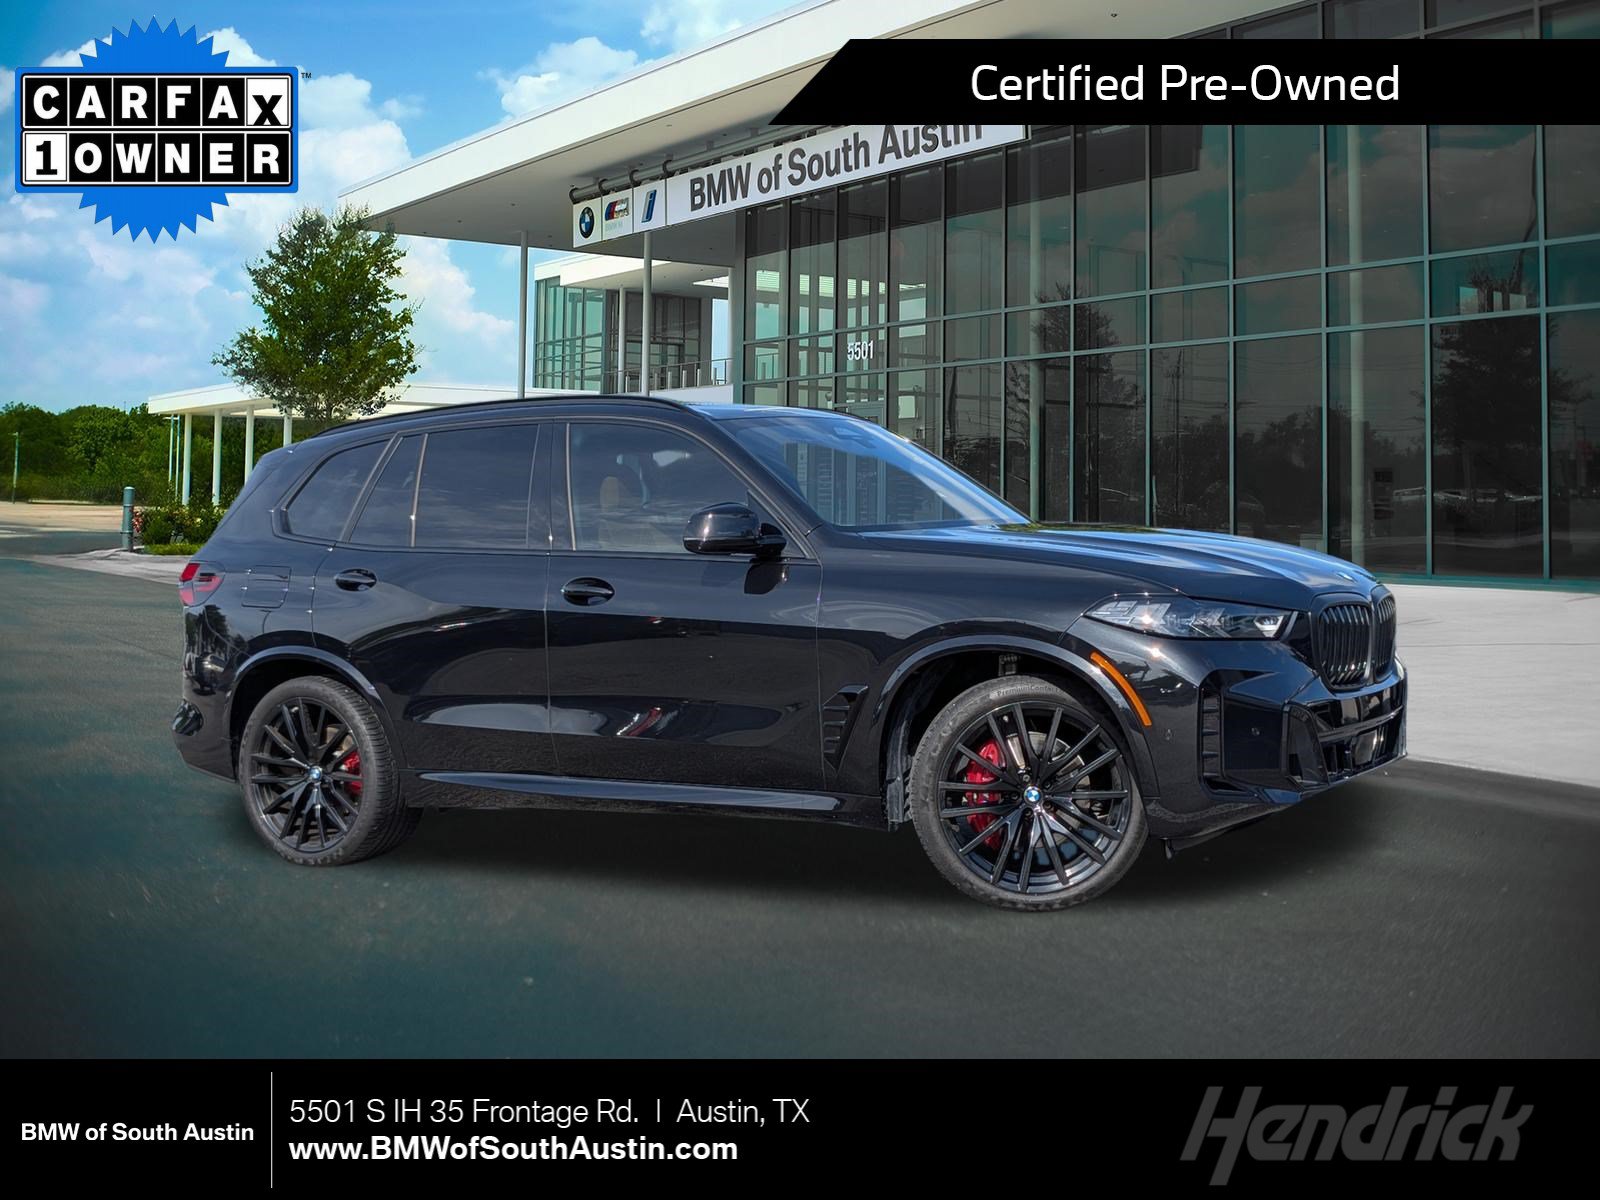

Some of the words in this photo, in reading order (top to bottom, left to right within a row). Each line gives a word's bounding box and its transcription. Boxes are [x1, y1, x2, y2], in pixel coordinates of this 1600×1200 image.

[690, 162, 751, 212] BMW
[757, 153, 782, 194] of
[787, 131, 870, 186] South
[847, 340, 873, 360] 5501
